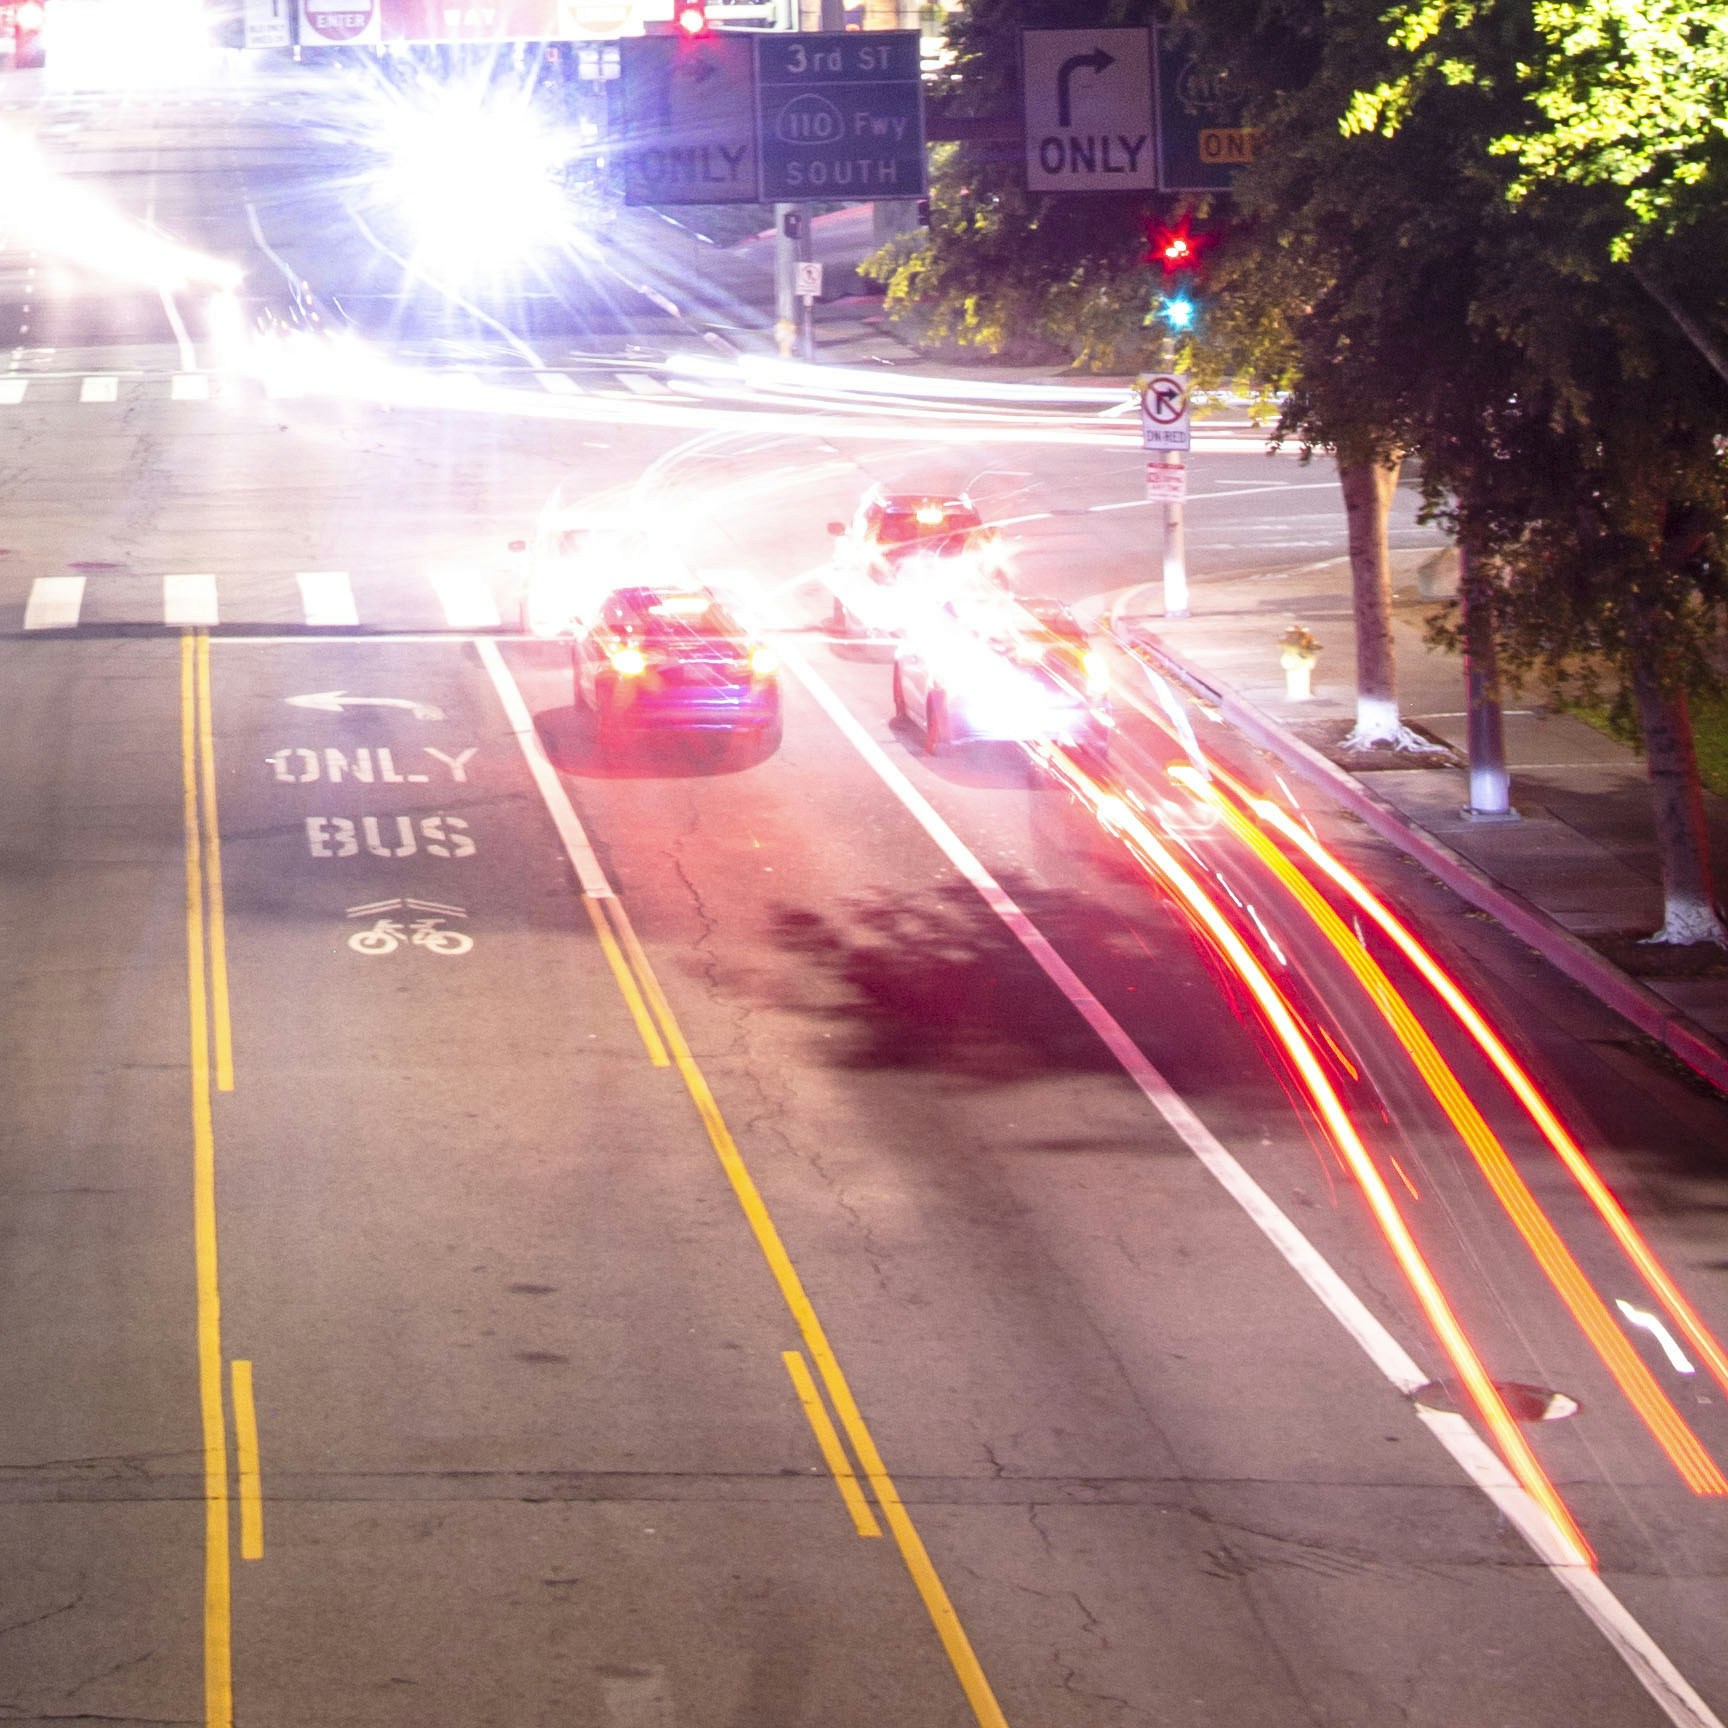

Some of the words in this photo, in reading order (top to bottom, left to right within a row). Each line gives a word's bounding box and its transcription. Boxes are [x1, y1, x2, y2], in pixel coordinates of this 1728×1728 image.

[317, 15, 365, 28] ENTER
[787, 43, 842, 72] 3rd
[858, 46, 892, 71] ST
[789, 112, 833, 138] 110
[854, 111, 908, 141] Fwy
[1038, 134, 1148, 175] ONLY
[786, 158, 898, 186] SOUTH
[273, 747, 479, 784] ONLY
[305, 816, 477, 858] BUS
